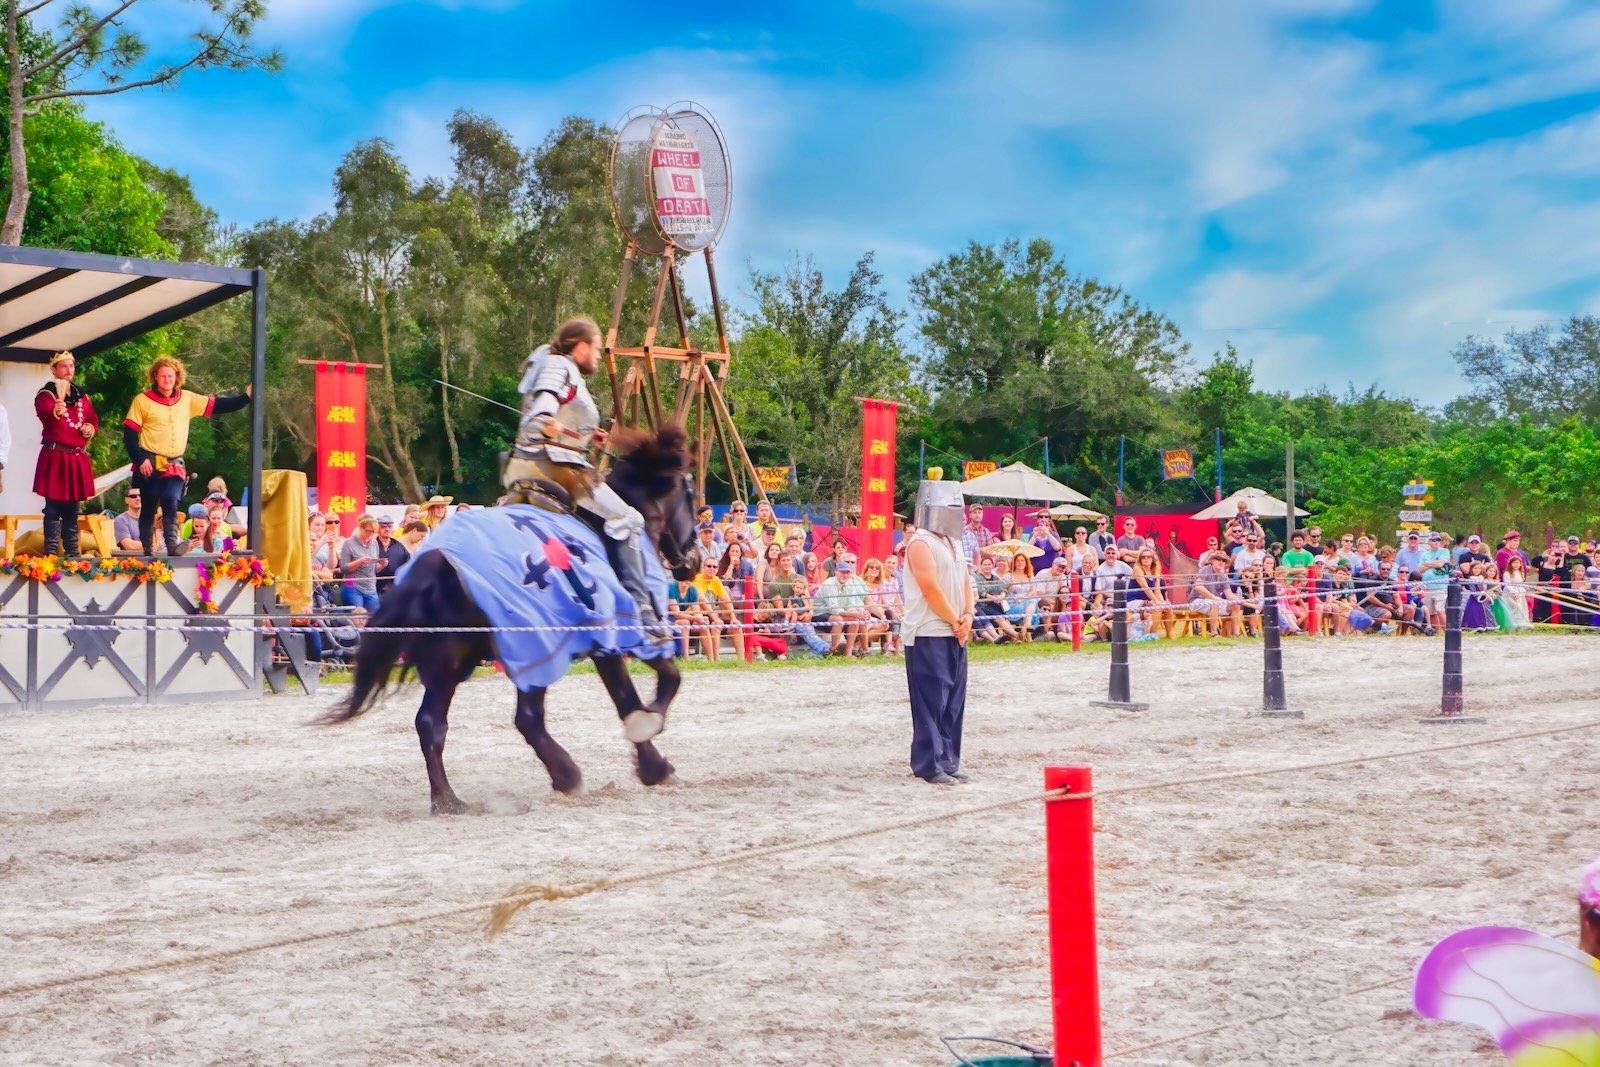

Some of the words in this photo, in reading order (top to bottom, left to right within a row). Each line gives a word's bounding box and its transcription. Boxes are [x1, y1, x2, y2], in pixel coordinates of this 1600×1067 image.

[657, 151, 700, 167] WHEEL
[676, 176, 690, 190] OF
[663, 200, 707, 213] DEATH
[968, 462, 993, 472] KNIFE
